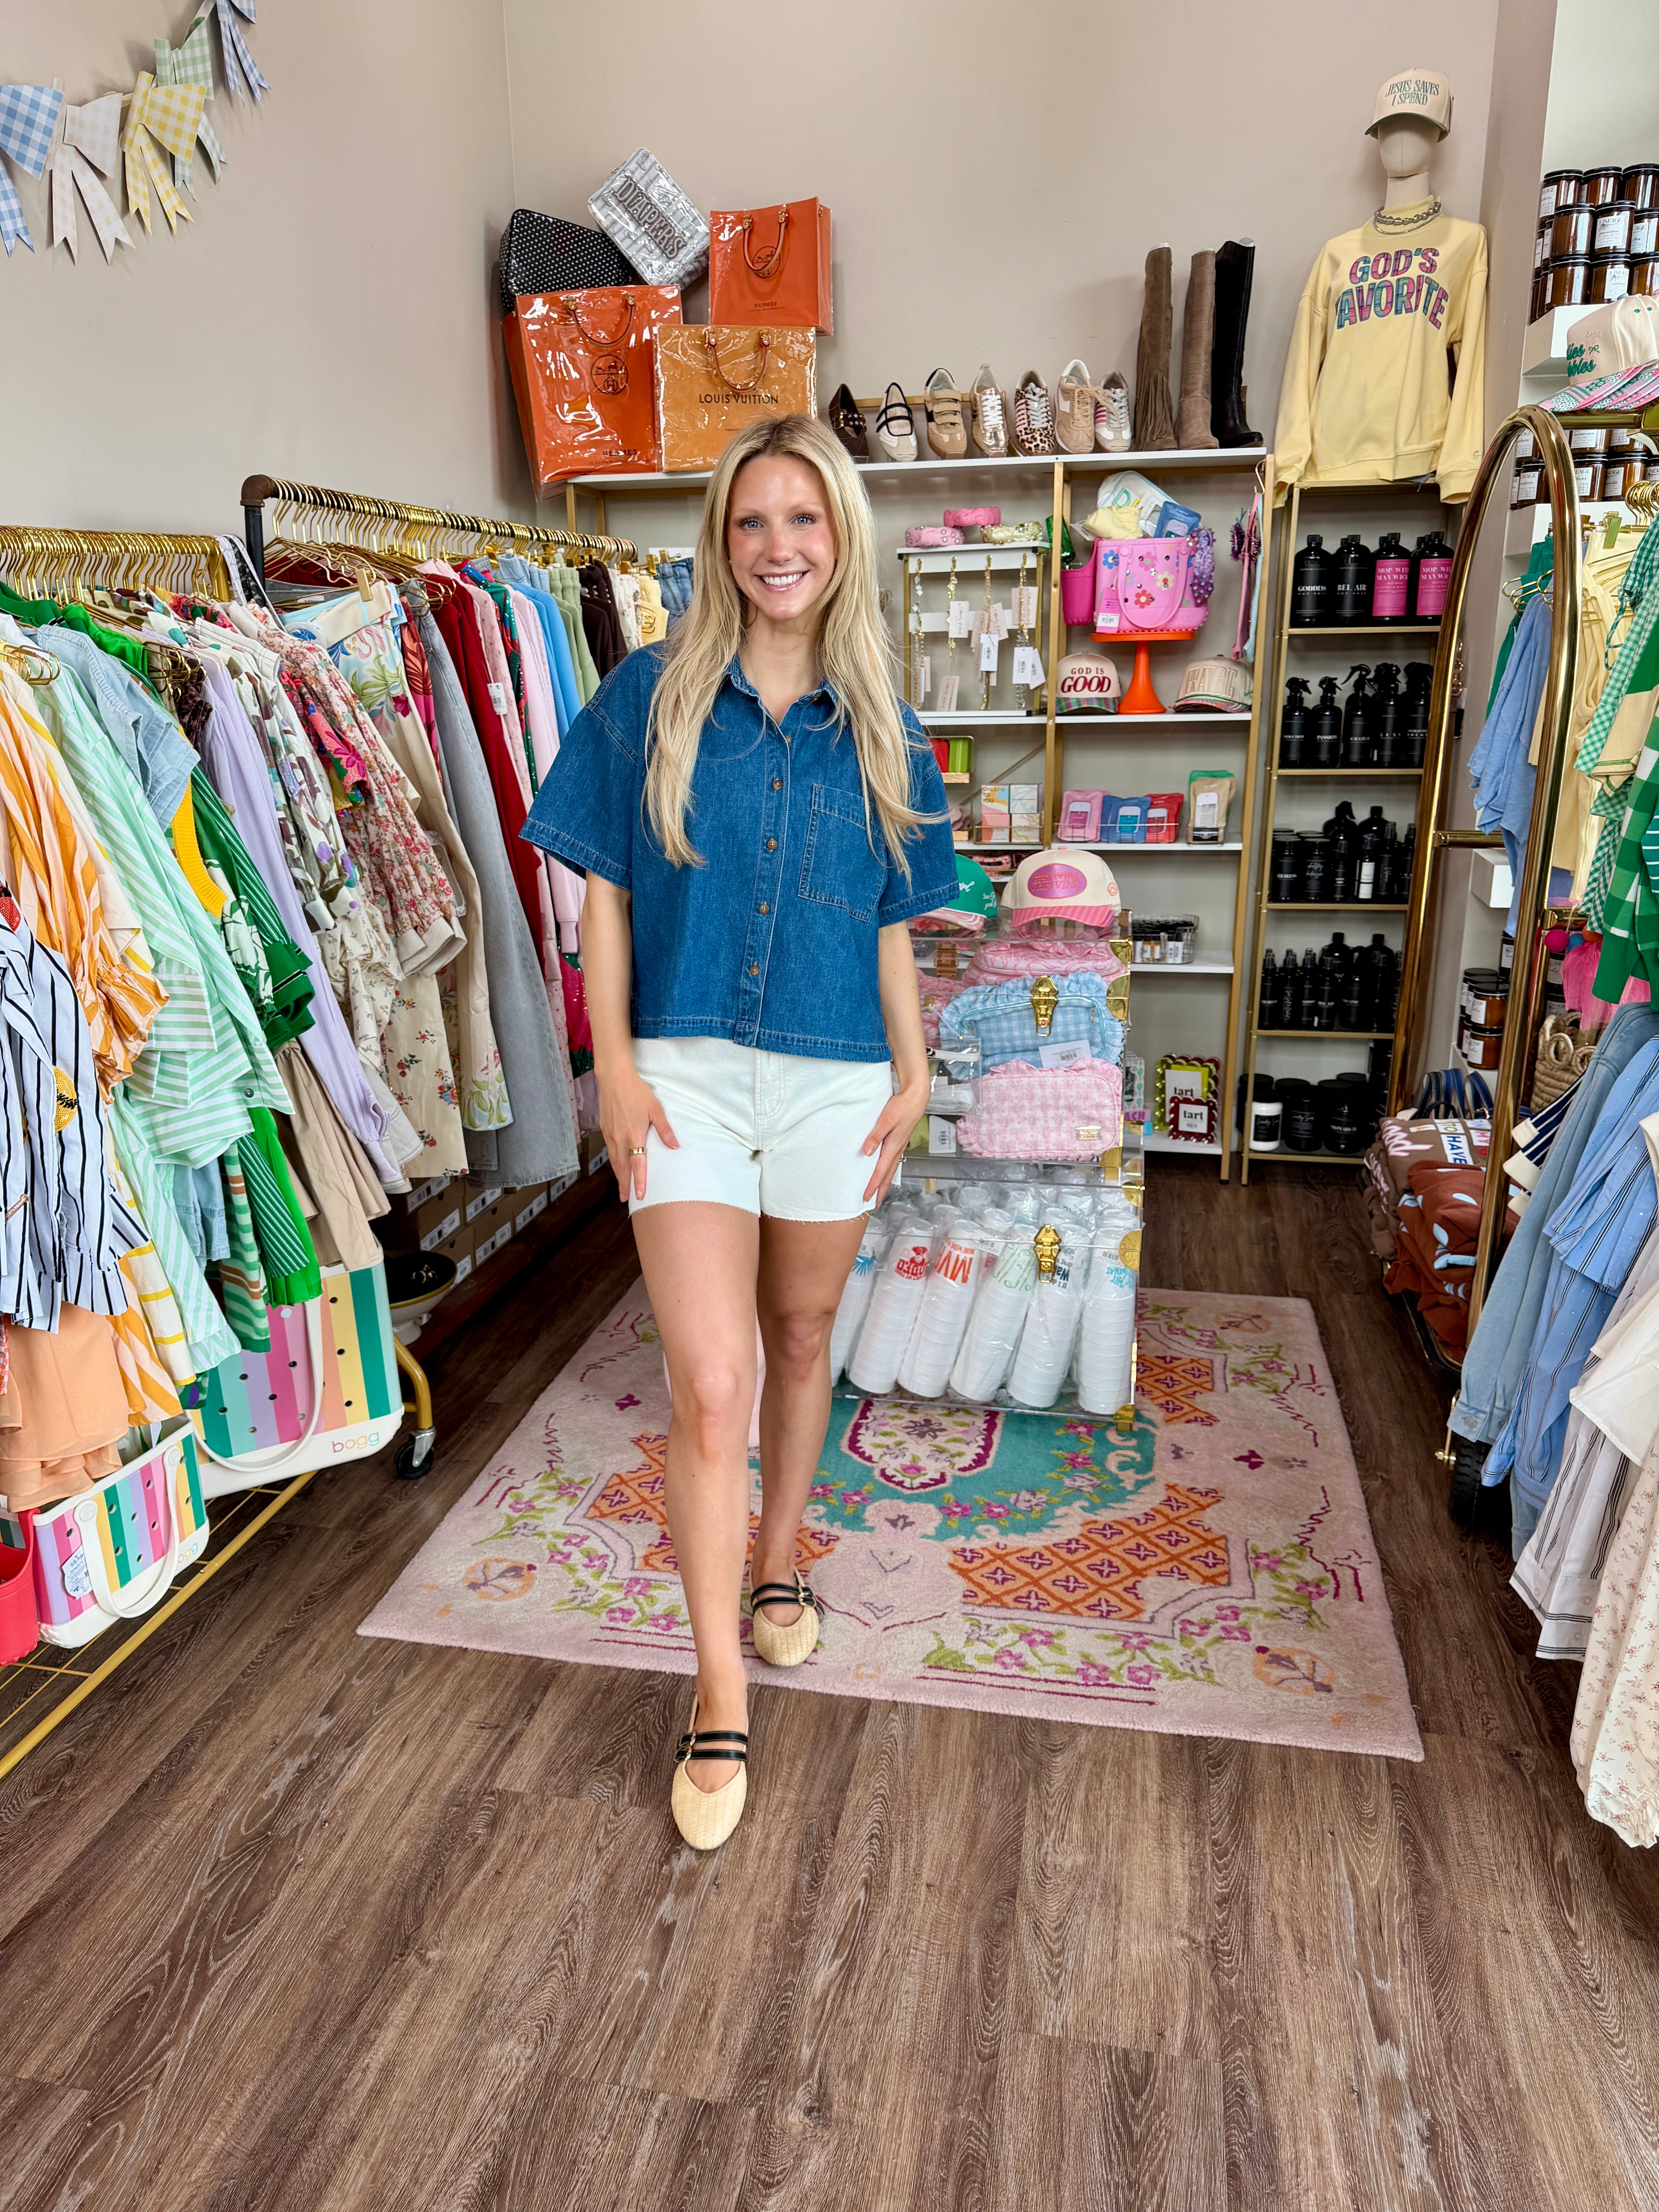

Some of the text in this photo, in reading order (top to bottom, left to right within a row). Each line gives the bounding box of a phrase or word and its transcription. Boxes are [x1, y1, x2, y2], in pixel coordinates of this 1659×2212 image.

[1385, 79, 1439, 97] JESUS SAVES
[1391, 92, 1428, 106] I SPEND
[613, 175, 687, 259] DIAPERS
[1349, 248, 1440, 285] GOD'S
[699, 393, 778, 404] LOUIS VUITTON
[1061, 675, 1111, 693] GOOD
[1032, 880, 1081, 891] THRIVING
[1174, 1087, 1193, 1097] tart
[1183, 1109, 1203, 1120] tart
[1475, 1131, 1490, 1144] MY
[1446, 1135, 1467, 1164] HAVE
[332, 1432, 380, 1453] bogg
